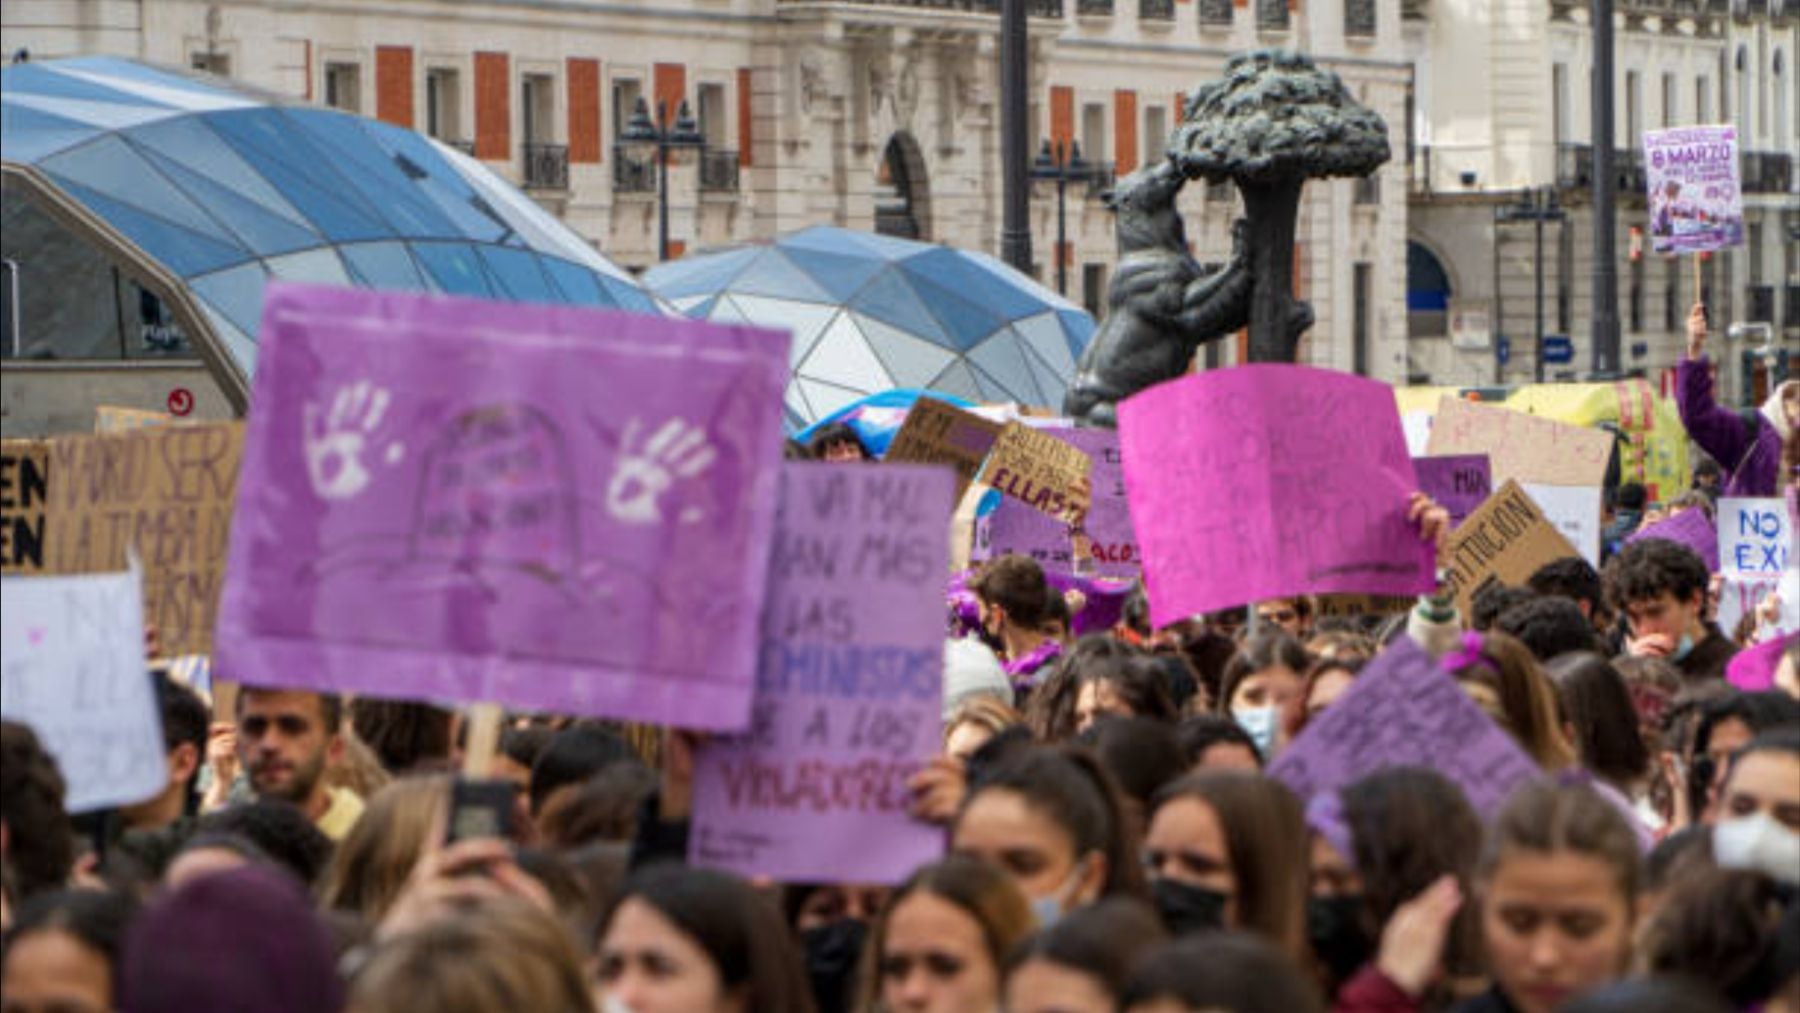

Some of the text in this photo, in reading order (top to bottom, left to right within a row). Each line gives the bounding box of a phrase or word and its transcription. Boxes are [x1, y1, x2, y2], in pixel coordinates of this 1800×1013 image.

[1668, 143, 1731, 164] MARZO
[991, 467, 1067, 514] ELLAS
[1738, 508, 1781, 538] NO
